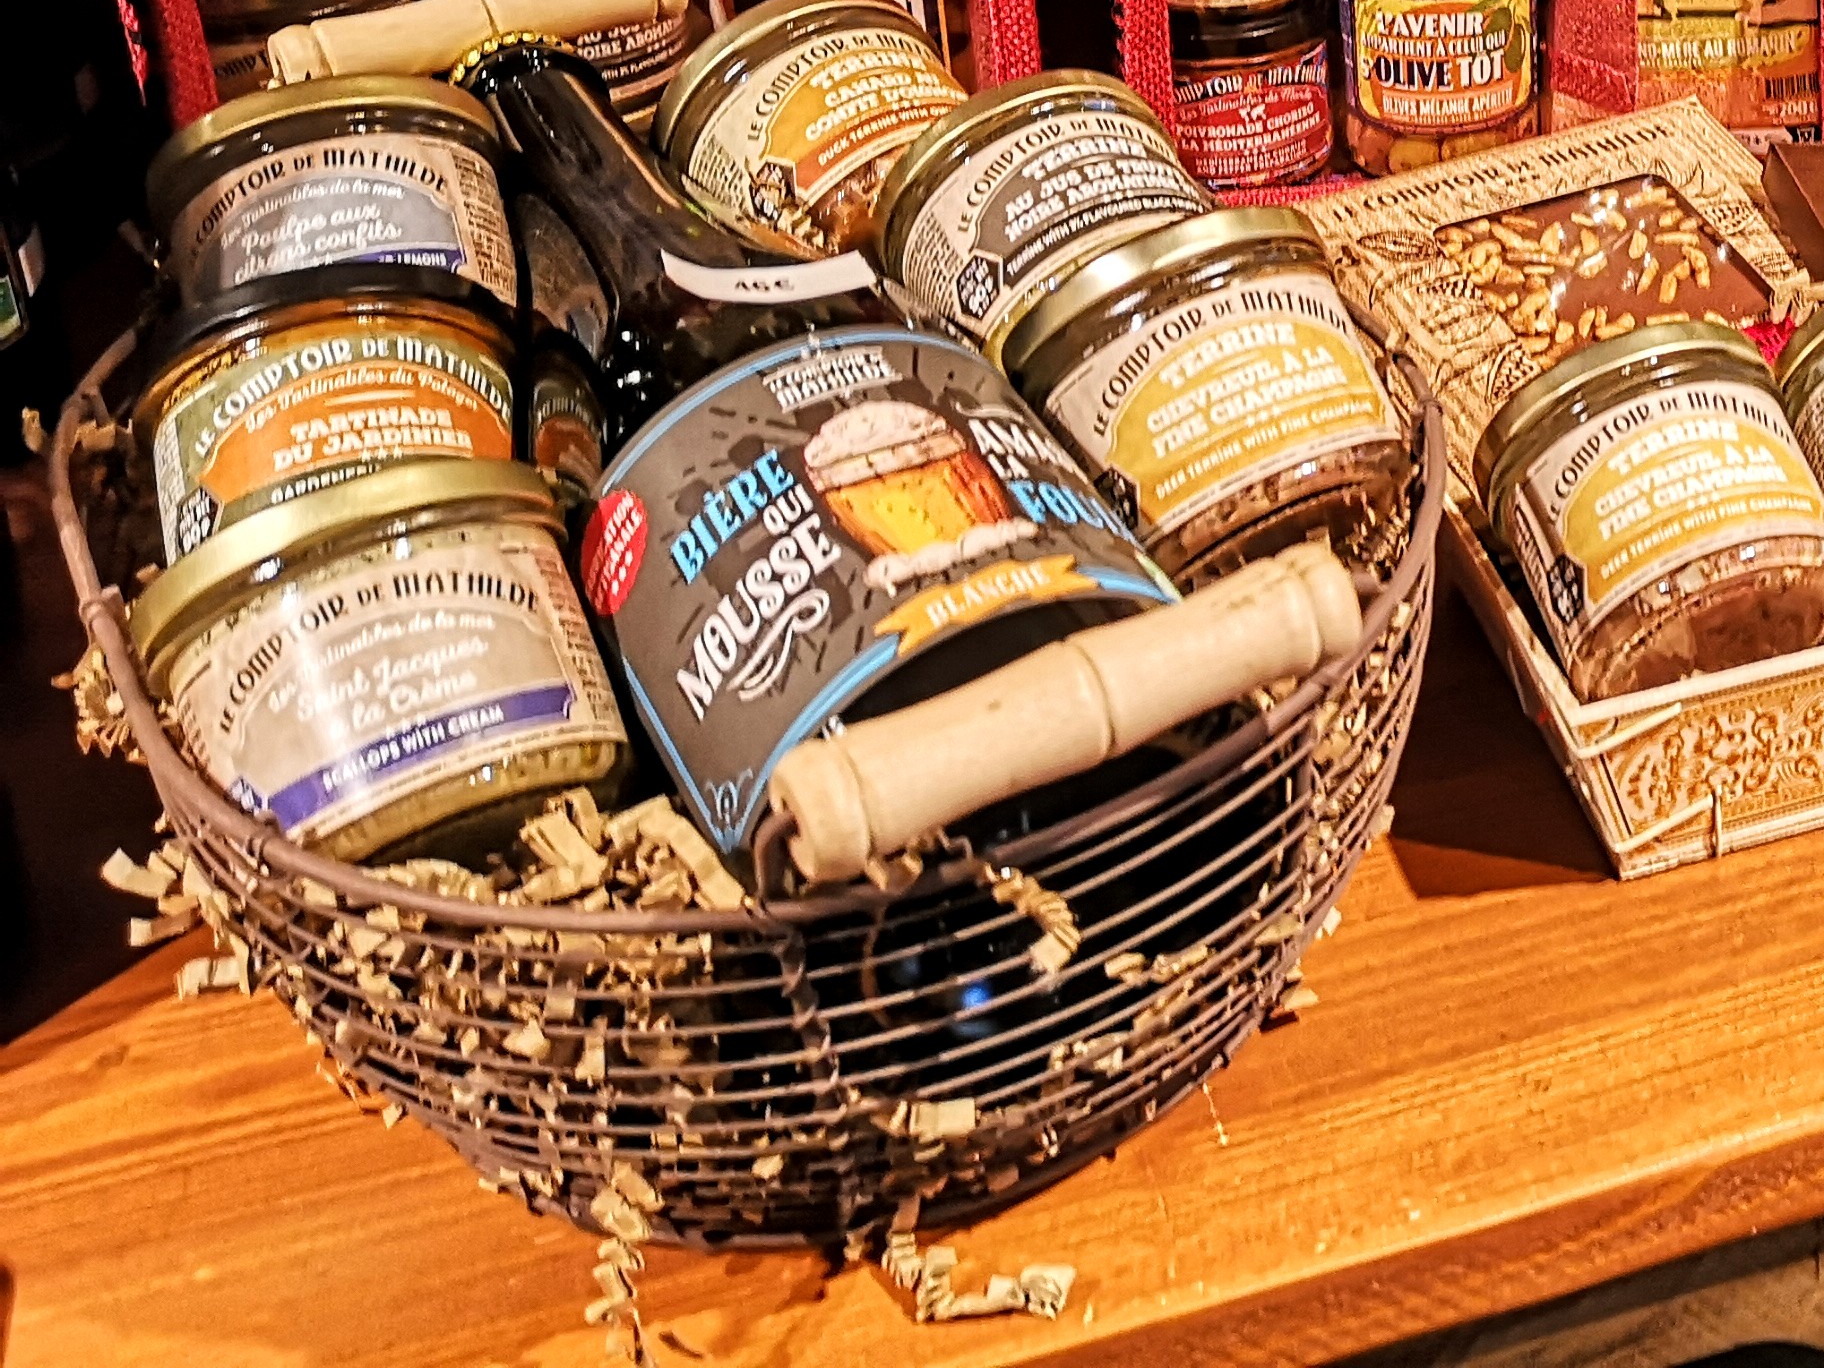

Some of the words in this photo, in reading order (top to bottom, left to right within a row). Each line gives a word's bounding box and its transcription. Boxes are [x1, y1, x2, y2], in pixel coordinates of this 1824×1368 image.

[1377, 11, 1484, 36] L'AVENIR
[810, 51, 927, 90] TERRINE
[824, 71, 912, 108] CANARD
[1459, 45, 1504, 87] TÔT
[805, 97, 880, 142] CONFIT
[293, 155, 316, 172] DE
[323, 147, 448, 193] MATHILDE
[1021, 135, 1148, 180] TERRINE
[331, 201, 381, 228] aux
[212, 336, 355, 427] COMPTOIR
[362, 337, 390, 358] DE
[396, 336, 513, 425] MATHILDE
[1102, 307, 1207, 409] COMPTOIR
[1160, 322, 1297, 388] TERRINE
[1146, 360, 1279, 433] CHEVREUIL
[1304, 345, 1334, 367] LA
[1151, 415, 1210, 460] FINE
[1210, 365, 1348, 426] CHAMPAGNE
[273, 443, 313, 472] DU
[321, 425, 472, 456] JARDINIER
[289, 407, 453, 443] TARTINADE
[1554, 402, 1651, 495] COMPTOIR
[1607, 420, 1740, 475] TERRINE
[1595, 451, 1723, 516] CHEVREUIL
[1745, 445, 1776, 464] LA
[1597, 500, 1652, 542] FINE
[1652, 463, 1789, 511] CHAMPAGNE
[668, 446, 797, 585] BIÈRE
[762, 480, 815, 537] QUI
[358, 584, 383, 609] DE
[393, 571, 541, 613] MATHILDE
[674, 513, 843, 722] MOUSSE
[925, 561, 1053, 629] BLANCHE
[373, 635, 489, 687] Jacques
[448, 704, 506, 738] CREAM
